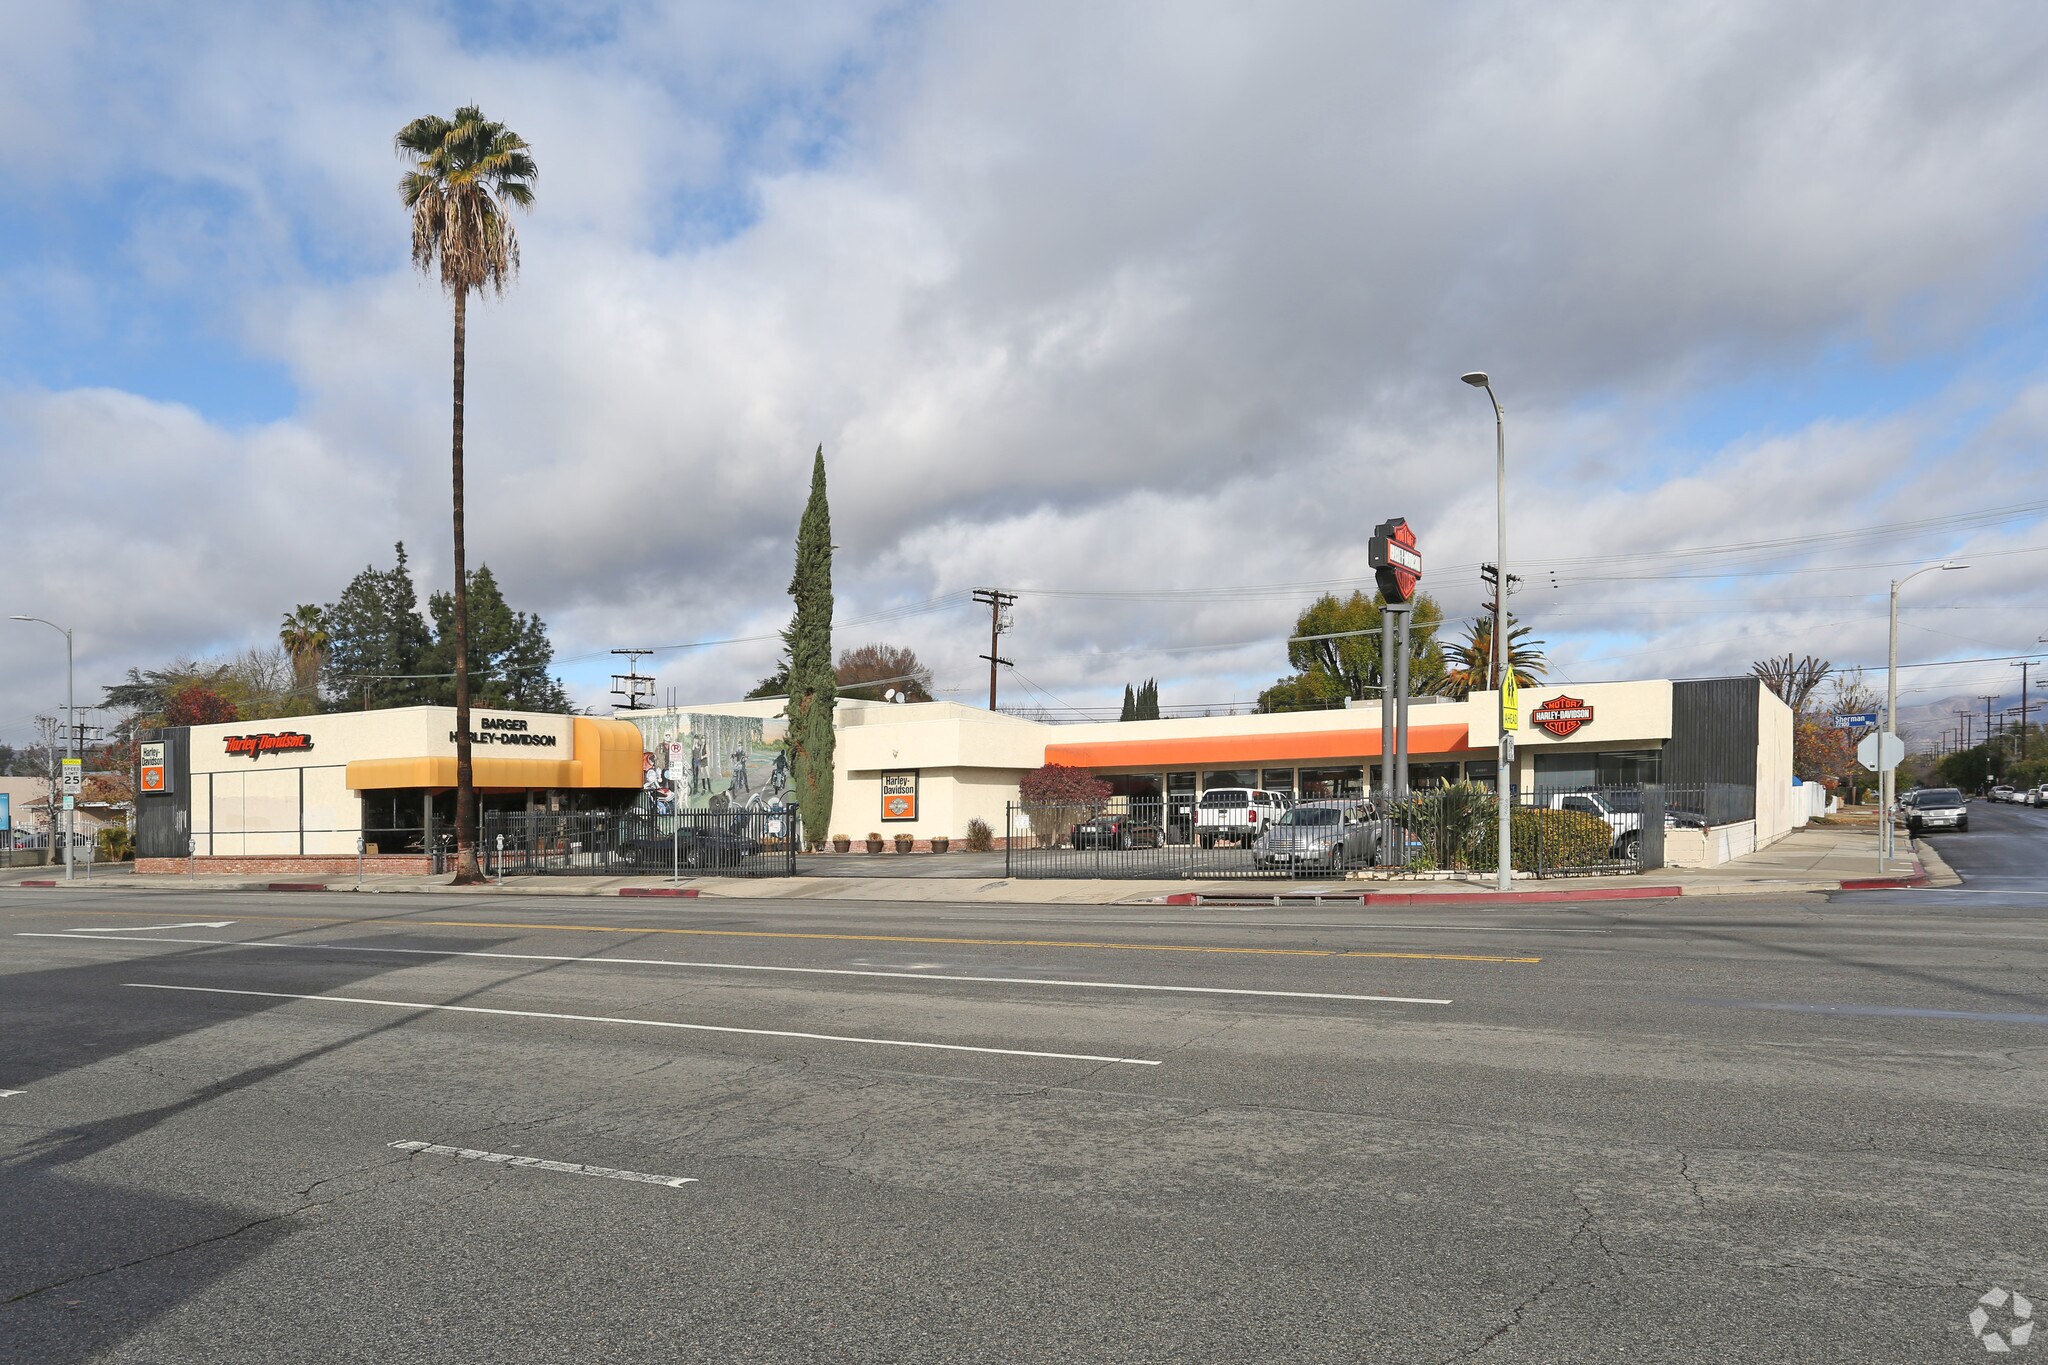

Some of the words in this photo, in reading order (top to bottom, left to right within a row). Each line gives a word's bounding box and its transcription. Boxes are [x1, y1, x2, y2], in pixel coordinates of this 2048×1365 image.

[1548, 699, 1577, 709] MOTOR
[1536, 709, 1590, 720] HARLEY-DAVIDSON
[1835, 715, 1866, 723] Sherman
[481, 717, 528, 731] BARGER
[1549, 720, 1577, 732] CYCLES
[223, 731, 309, 757] Harley-Davidson
[449, 731, 557, 747] HRLEY-DAVIDSON
[143, 747, 161, 757] Harley-
[142, 757, 163, 766] Davidson
[64, 775, 80, 785] 25
[885, 775, 910, 786] Harley-
[883, 785, 914, 795] Davidson
